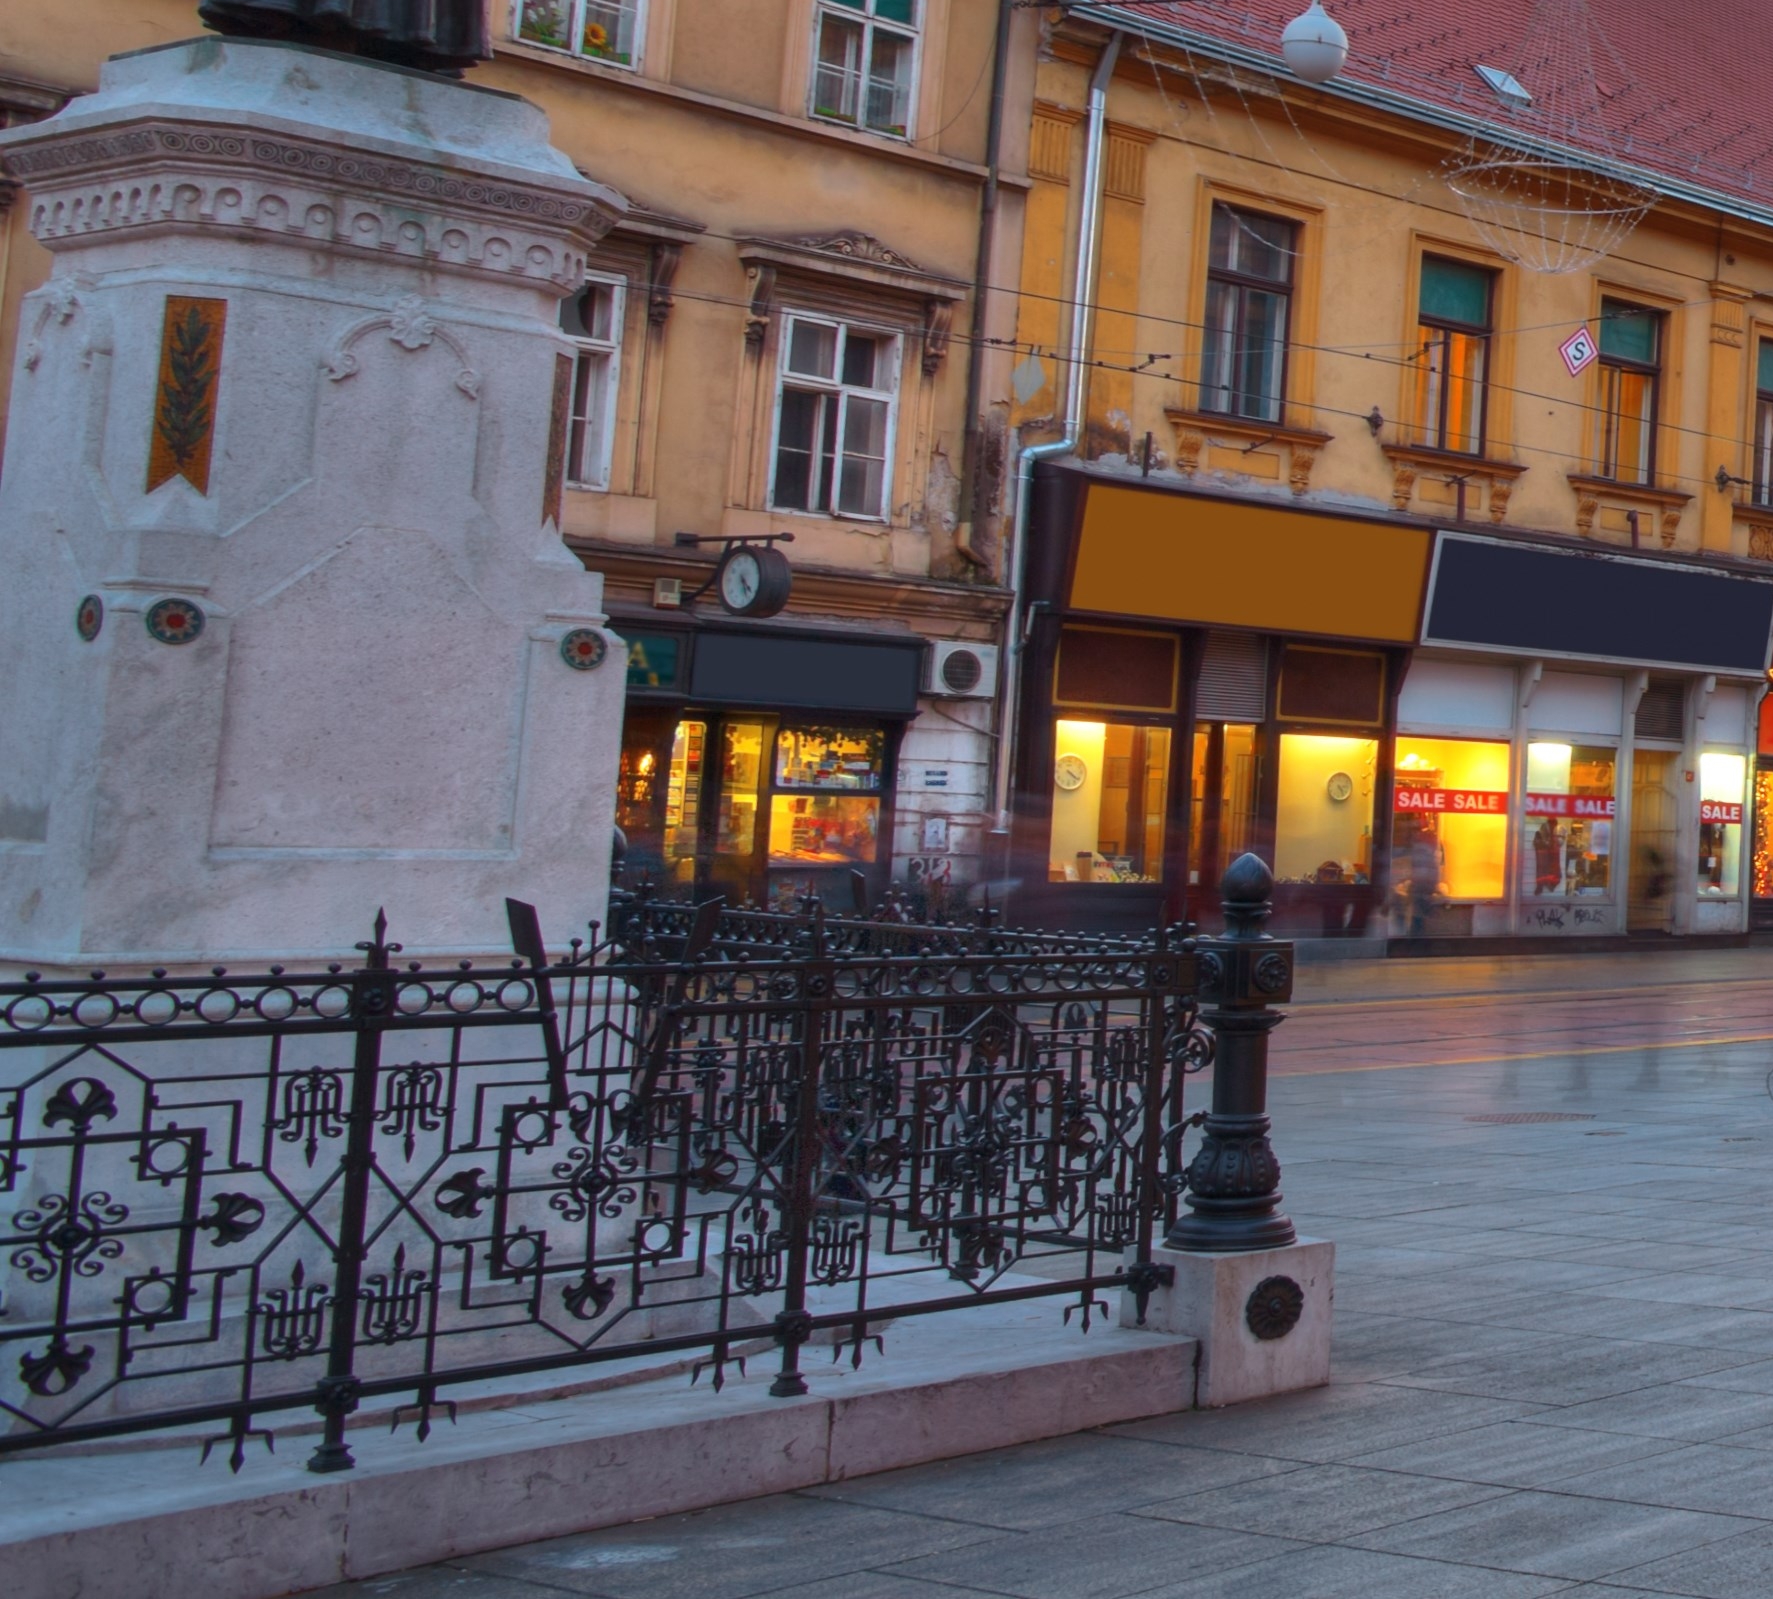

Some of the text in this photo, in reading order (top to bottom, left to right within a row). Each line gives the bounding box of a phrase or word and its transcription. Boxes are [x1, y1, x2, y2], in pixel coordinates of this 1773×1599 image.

[1572, 341, 1586, 361] S
[1398, 791, 1499, 811] SALE SALE
[1525, 796, 1616, 815] SALE SALE
[1702, 804, 1741, 820] SALE
